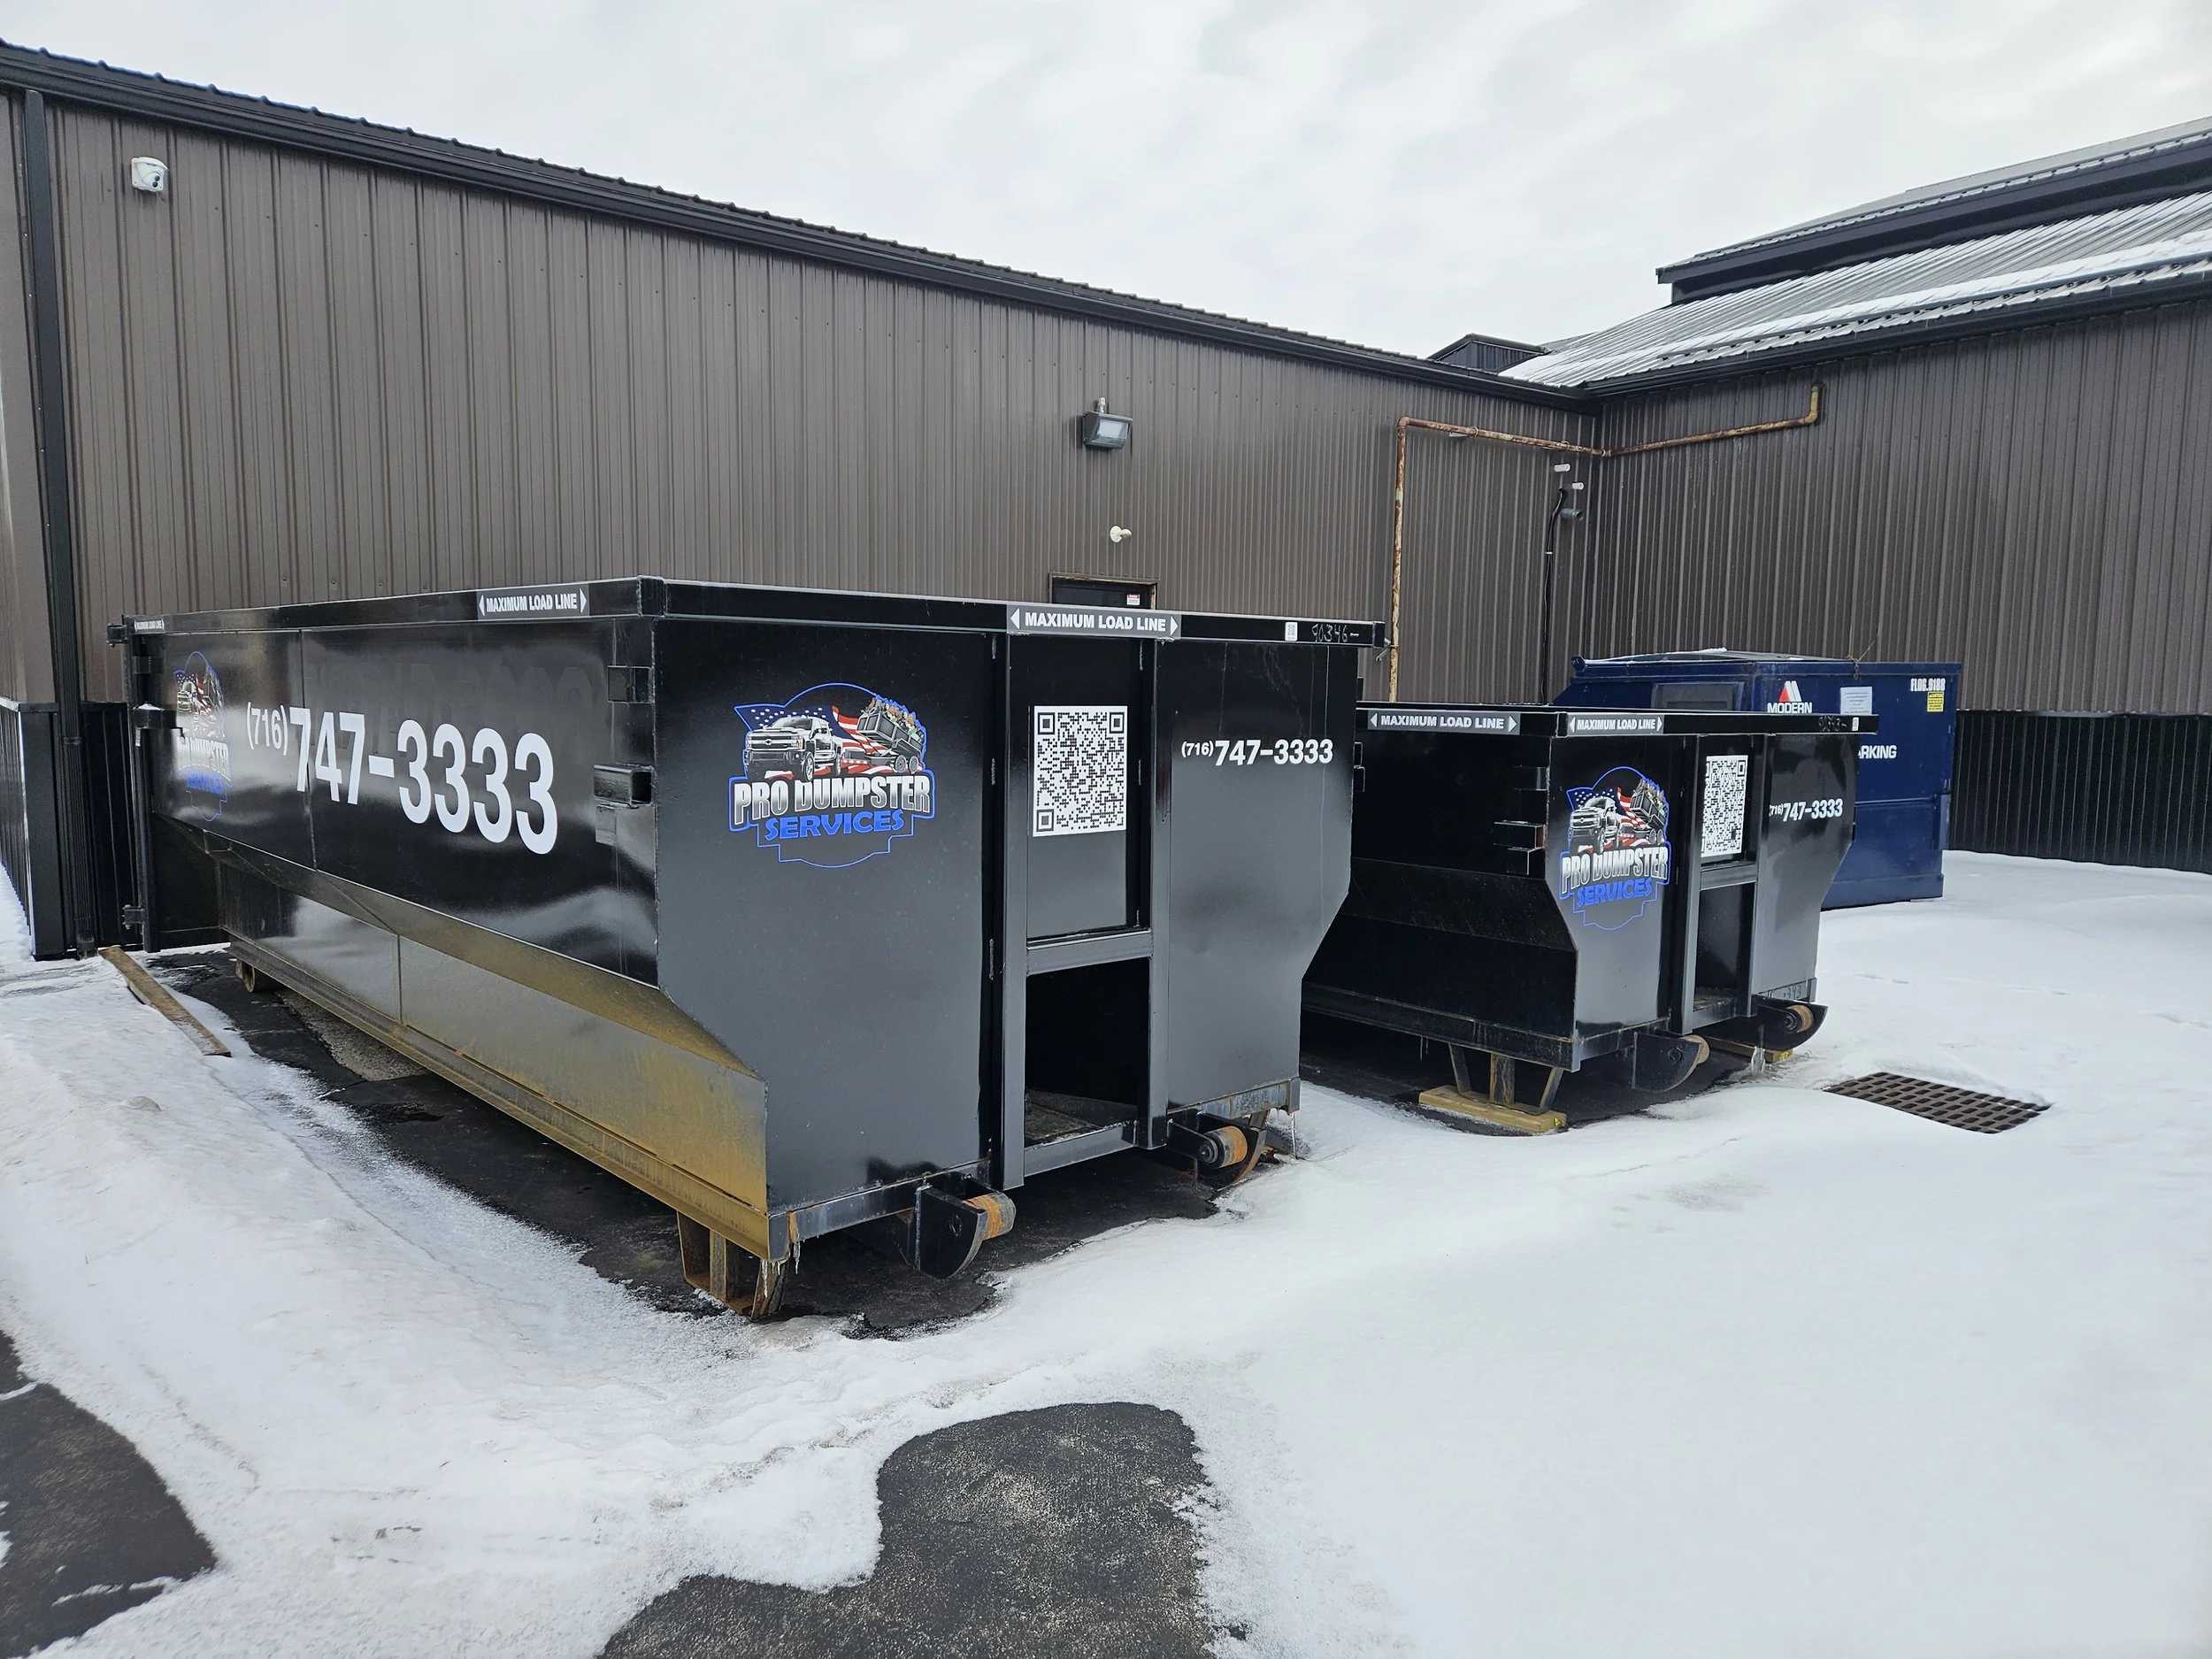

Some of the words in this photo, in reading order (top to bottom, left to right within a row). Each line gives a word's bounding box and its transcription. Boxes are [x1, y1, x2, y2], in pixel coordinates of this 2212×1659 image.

[487, 595, 527, 612] MAXIMUM
[529, 595, 553, 611] LOAD
[555, 594, 577, 610] LINE
[1025, 612, 1094, 628] MAXIMUM
[1099, 615, 1133, 630] LOAD
[1137, 618, 1166, 632] LINE
[1767, 702, 1812, 713] MODERN
[1380, 715, 1437, 726] MAXIMUM
[1440, 717, 1471, 727] LOAD
[1475, 718, 1504, 730] LINE
[1577, 719, 1616, 730] MAXIMUM
[1617, 719, 1637, 730] LOAD
[1639, 719, 1655, 730] LINE
[733, 780, 789, 826] PRO
[795, 775, 930, 813] DUMPSTER
[764, 809, 904, 841] SERVICES
[1562, 853, 1591, 895] PRO
[1593, 846, 1668, 881] DUMPSTER
[1577, 877, 1652, 907] SERVICES
